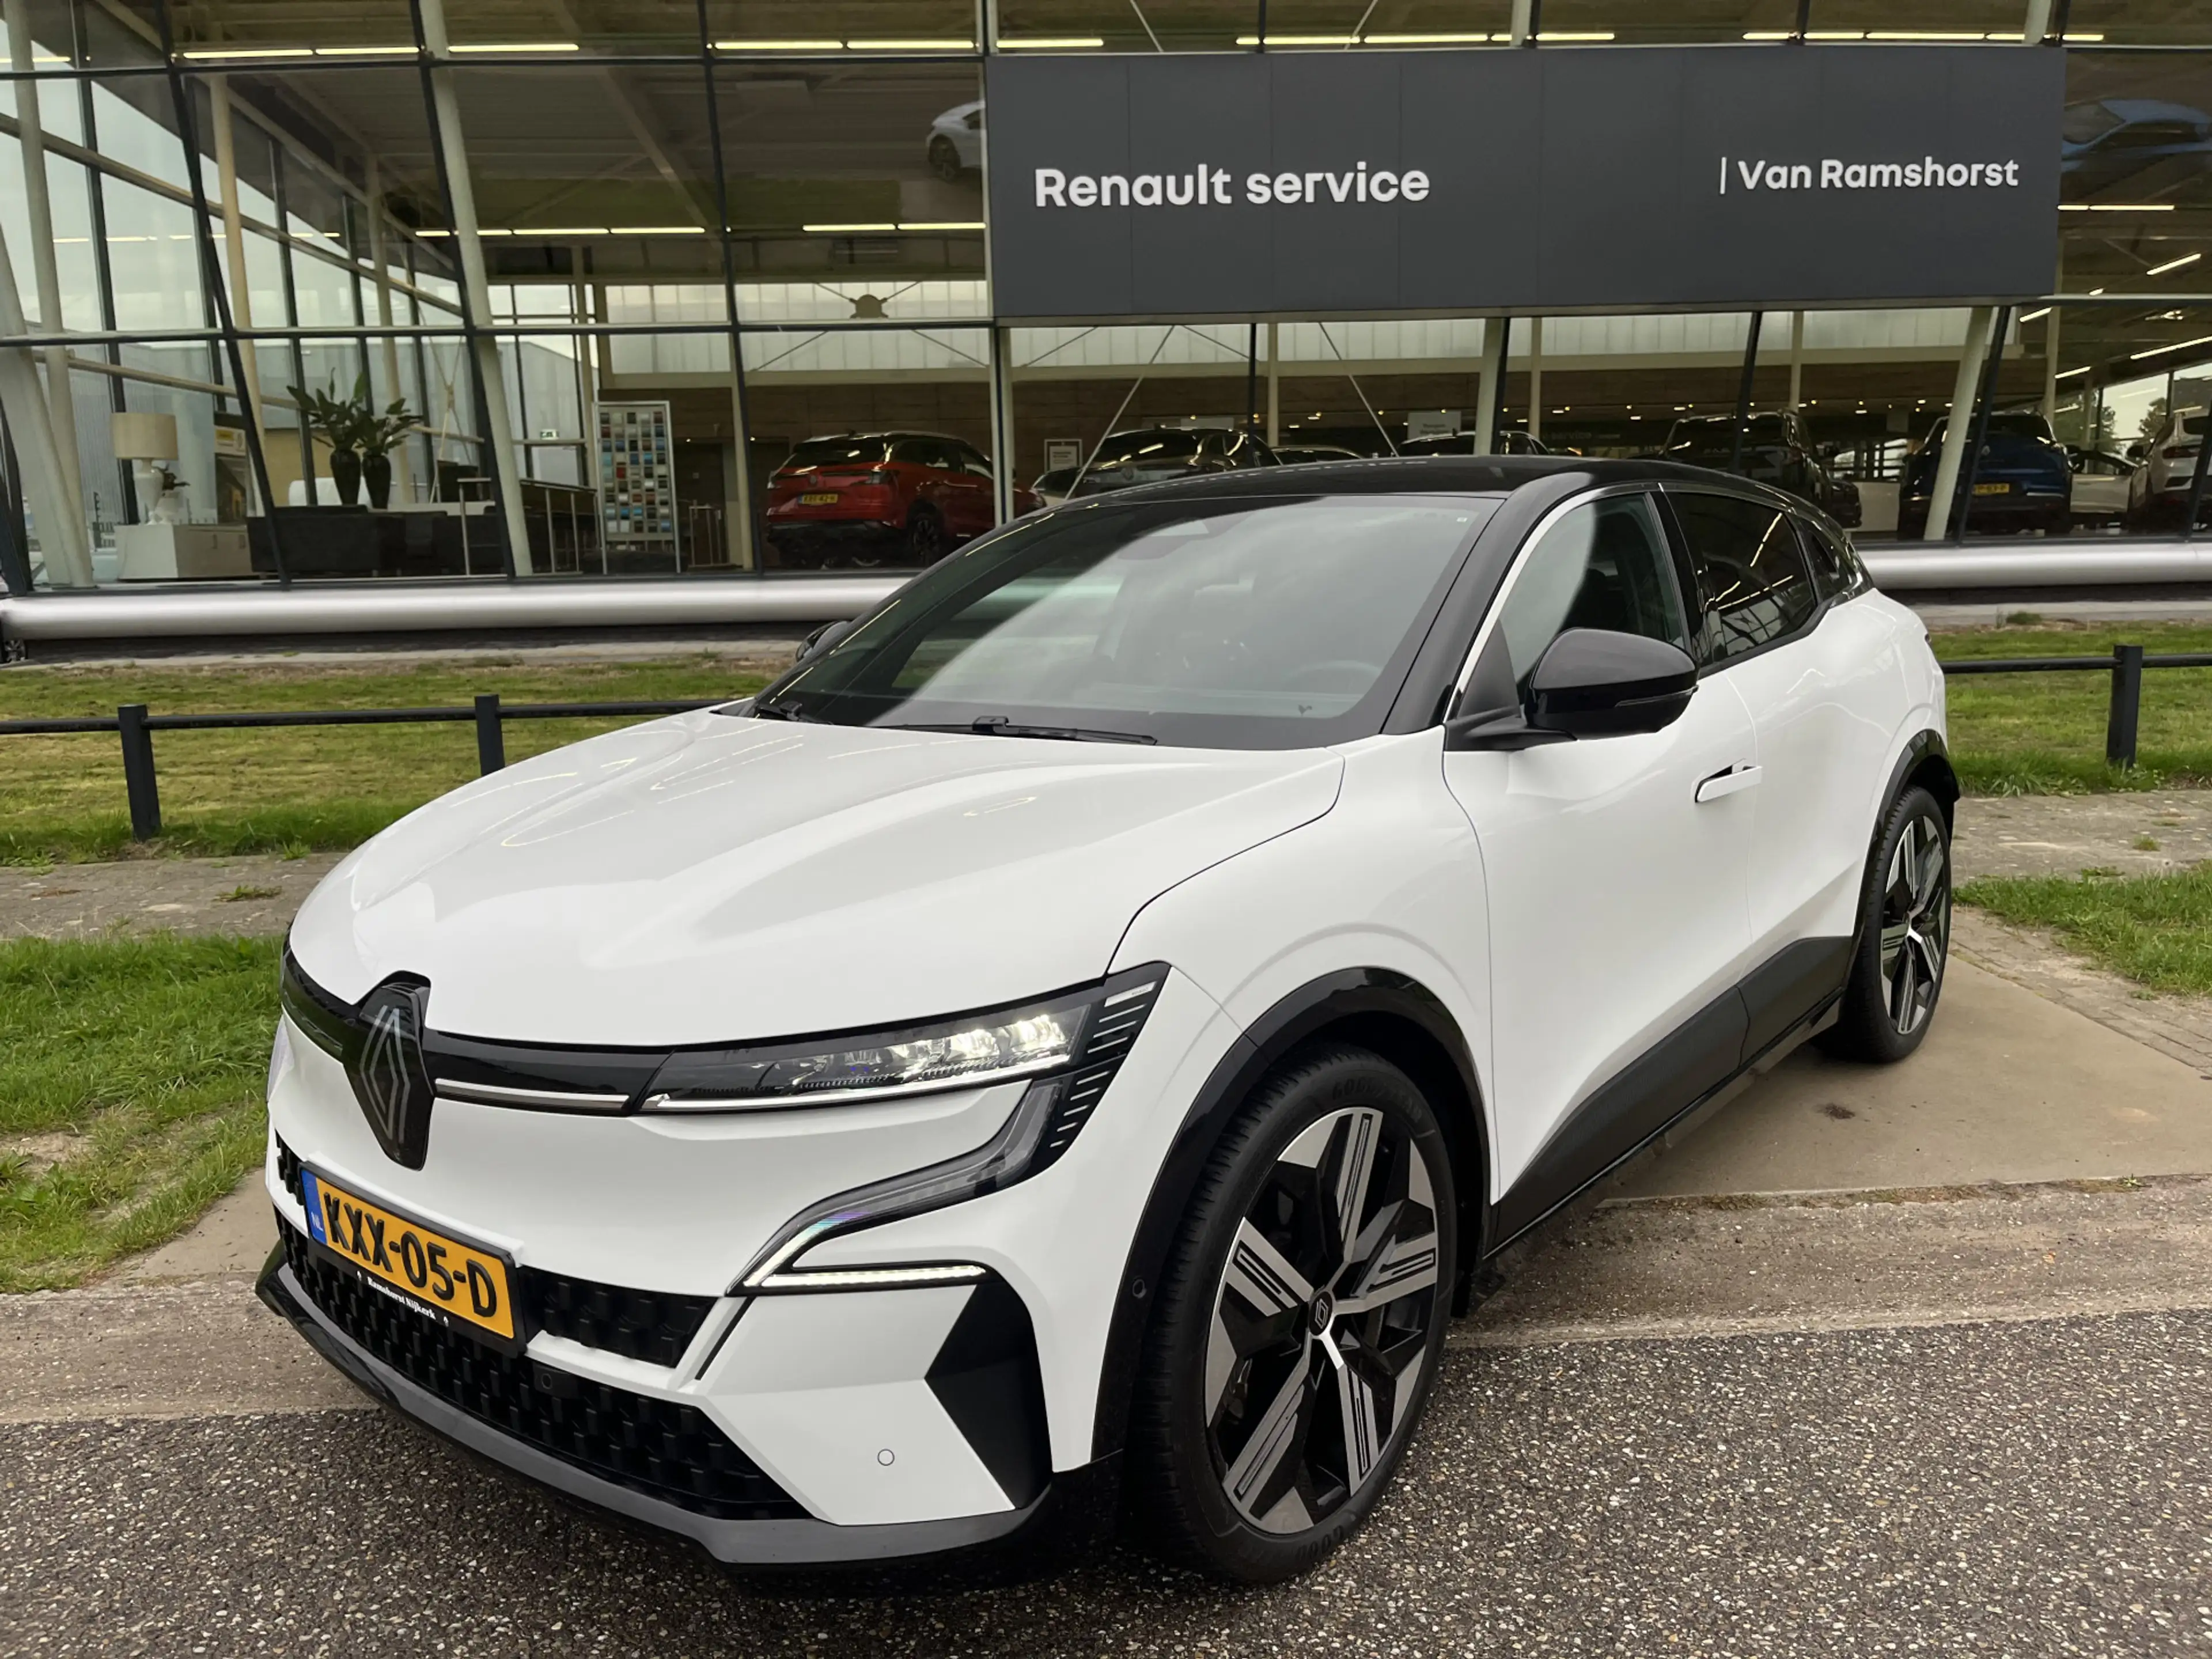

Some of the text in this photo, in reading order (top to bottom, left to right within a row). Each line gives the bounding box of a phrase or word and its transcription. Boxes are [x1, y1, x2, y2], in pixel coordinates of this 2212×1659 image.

[1035, 161, 1430, 207] Renault service
[1737, 156, 2020, 190] Van Ramshorst
[324, 1192, 497, 1318] KXX-05-D
